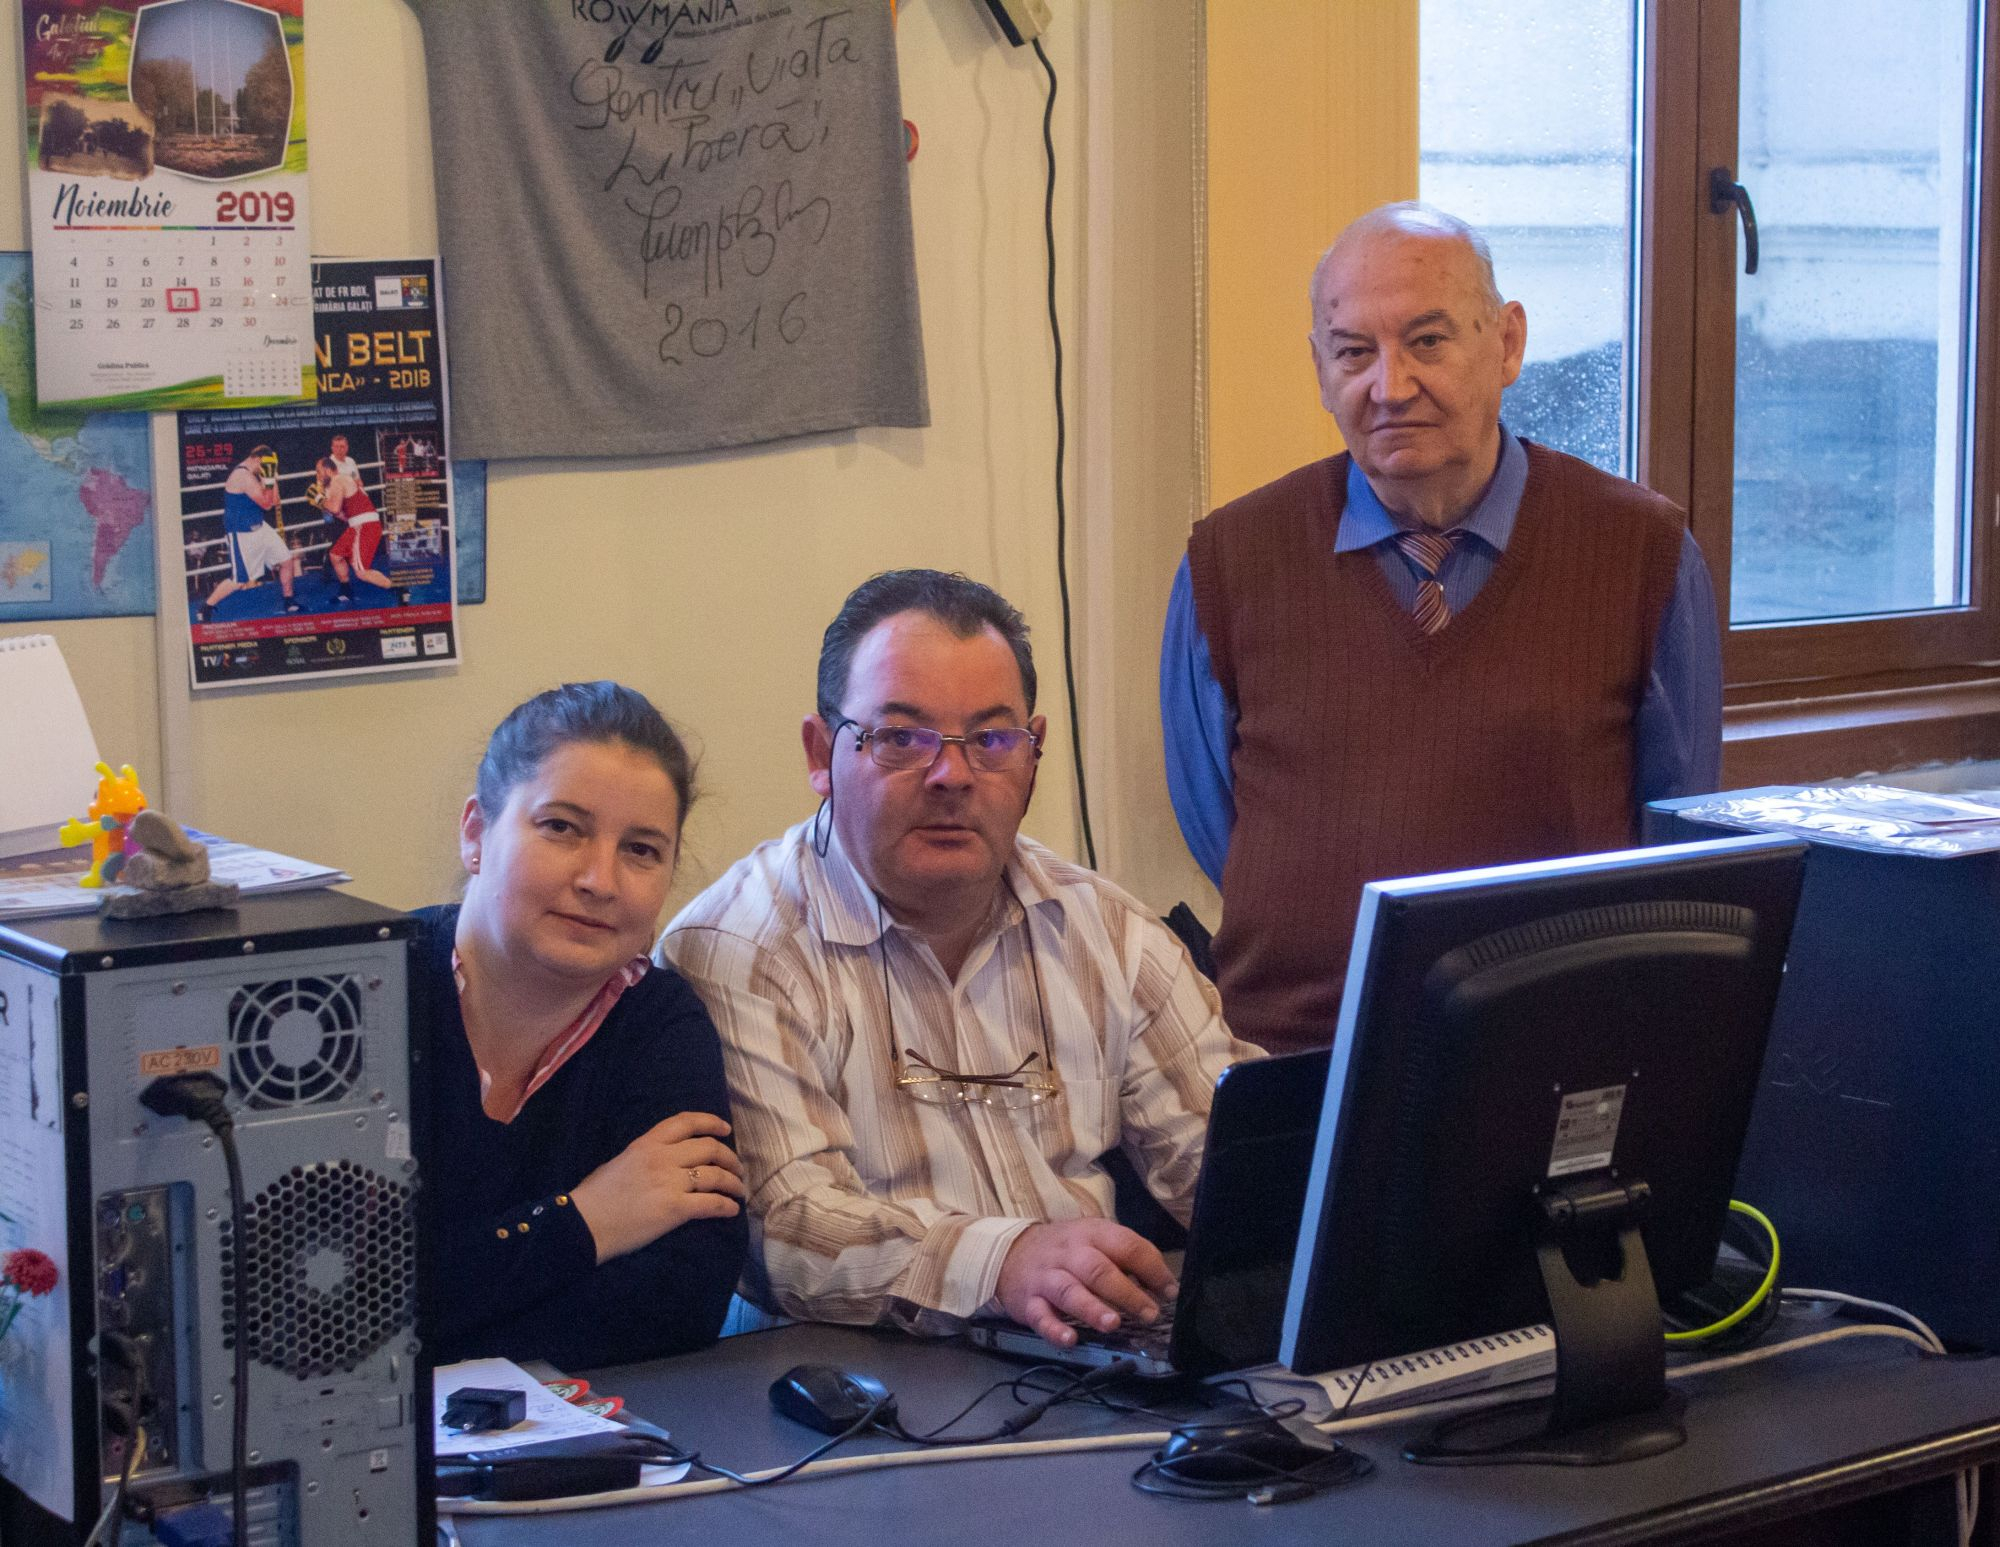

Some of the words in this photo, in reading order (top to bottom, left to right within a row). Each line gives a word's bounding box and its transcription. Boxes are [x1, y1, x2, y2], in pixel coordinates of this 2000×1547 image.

[53, 183, 174, 225] Noiembrie
[216, 190, 295, 222] 2019
[243, 236, 250, 247] 2
[69, 256, 78, 268] 4
[107, 256, 115, 267] 5
[142, 256, 151, 267] 6
[177, 256, 185, 267] 7
[210, 256, 218, 267] 8
[243, 256, 252, 267] 9
[274, 256, 286, 267] 10
[70, 277, 80, 288] 11
[105, 277, 118, 288] 12
[141, 276, 153, 288] 13
[175, 276, 188, 288] 14
[210, 276, 221, 287] 15
[243, 276, 254, 287] 16
[275, 276, 286, 287] 17
[325, 286, 337, 298] DE
[338, 285, 349, 297] FR
[70, 298, 82, 309] 18
[106, 297, 119, 309] 19
[140, 298, 156, 309] 20
[176, 297, 189, 309] 21
[209, 297, 223, 308] 22
[275, 296, 289, 308] 24
[69, 318, 84, 330] 25
[106, 318, 121, 330] 26
[142, 318, 156, 329] 27
[176, 318, 190, 329] 28
[210, 317, 224, 328] 29
[242, 317, 257, 328] 30
[659, 292, 807, 366] 2016
[347, 329, 431, 367] BELT
[388, 368, 431, 389] 2018
